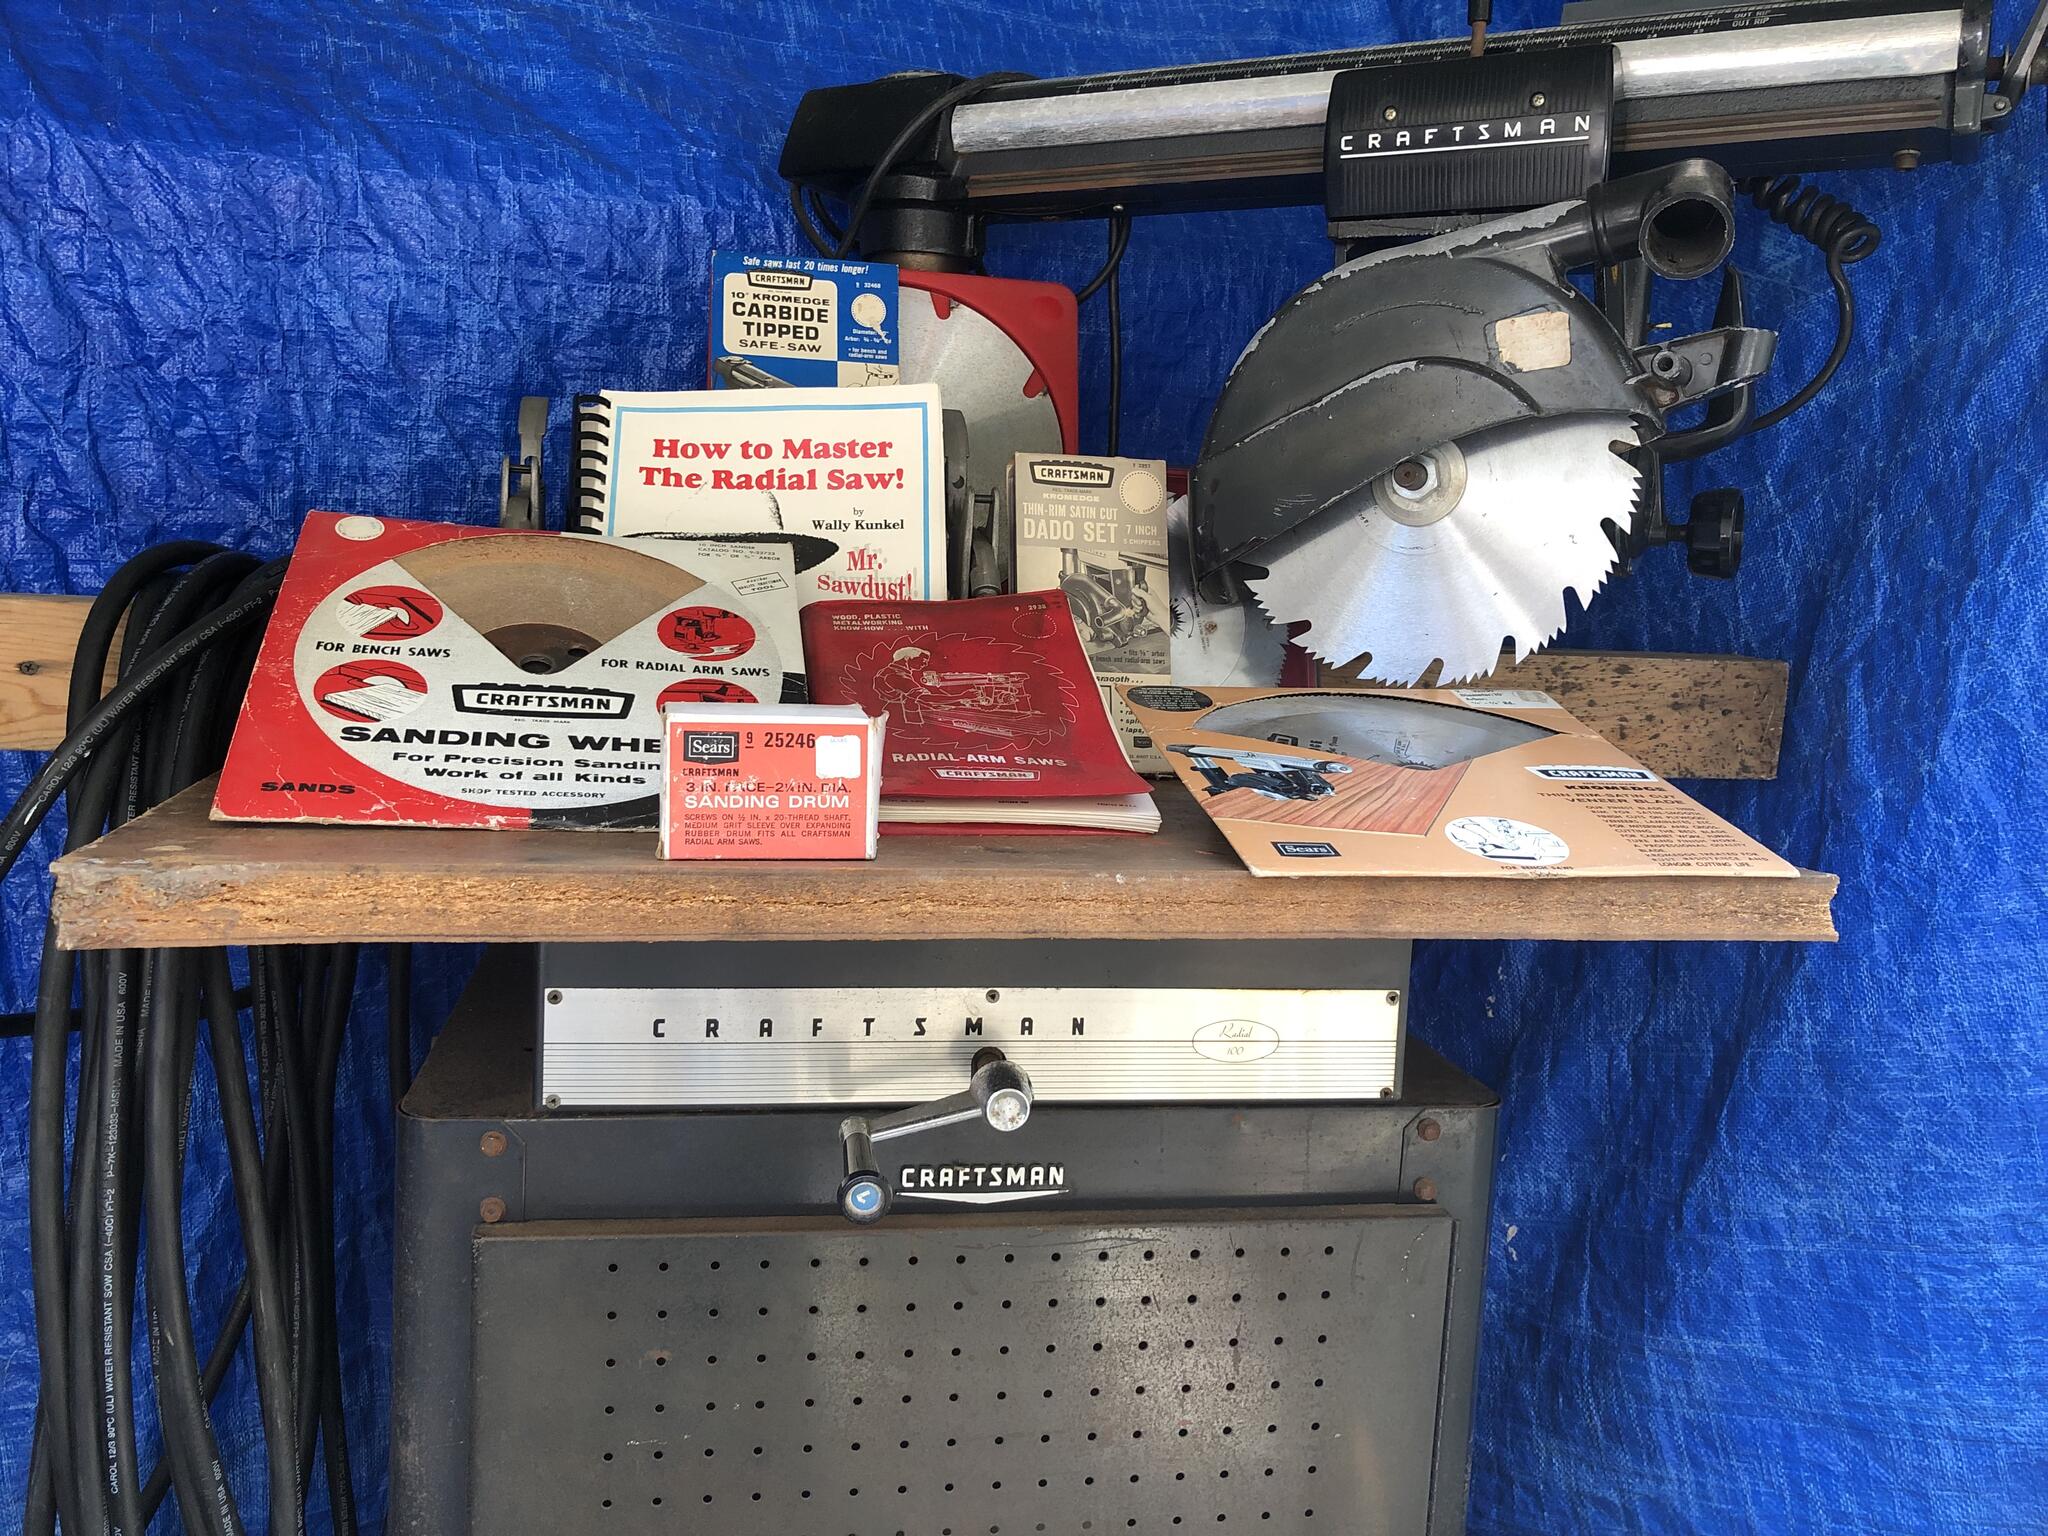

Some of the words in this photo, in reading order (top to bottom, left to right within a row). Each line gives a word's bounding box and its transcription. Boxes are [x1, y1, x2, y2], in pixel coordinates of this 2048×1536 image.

[1340, 115, 1590, 151] CRAFTSMAN
[743, 256, 760, 266] Safe
[763, 258, 782, 268] saws
[786, 259, 800, 269] last
[804, 261, 815, 270] 20
[817, 262, 838, 272] times
[841, 264, 870, 275] longer!
[755, 273, 805, 286] CRAFTSMAN
[752, 293, 830, 306] KROMEDGE
[732, 302, 829, 324] CARBIDE
[742, 321, 820, 340] TIPPED
[652, 438, 732, 460] How
[740, 440, 772, 460] to
[782, 438, 893, 460] Master
[639, 466, 702, 489] The
[712, 467, 819, 491] Radial
[827, 468, 904, 491] Saw!
[1041, 468, 1104, 481] CRAFTSMAN
[853, 507, 864, 517] by
[1023, 502, 1066, 518] THIN-RIM
[1070, 506, 1097, 519] SATIN
[1100, 508, 1118, 520] CUT
[812, 520, 850, 532] Wally
[855, 519, 904, 530] Kunkel
[1024, 518, 1074, 540] DADO
[1083, 521, 1118, 544] SET
[1135, 525, 1157, 536] INCH
[847, 548, 882, 571] Mr.
[817, 573, 912, 601] Sawdust!
[316, 640, 346, 652] FOR
[352, 644, 400, 656] BENCH
[408, 647, 450, 658] SAWS
[601, 658, 628, 668] FOR
[636, 661, 686, 672] RADIAL
[692, 666, 724, 675] ARM
[731, 667, 770, 677] SAWS
[476, 692, 610, 710] CRAFTSMAN
[39, 764, 65, 802] CAROL
[62, 754, 78, 772] 12/3
[106, 692, 137, 722] WATER
[135, 652, 178, 692] RESISTANT
[178, 639, 199, 655] SOW
[198, 626, 218, 641] CSA
[340, 726, 550, 749] SANDING
[764, 732, 816, 749] 25246
[692, 740, 730, 754] Sears
[393, 752, 434, 761] For
[444, 754, 564, 768] Precision
[892, 752, 1006, 764] RADIAL-ARM
[1014, 756, 1068, 766] SAWS
[424, 768, 488, 779] Work
[499, 771, 523, 781] of
[532, 772, 563, 782] all
[575, 773, 646, 785] Kinds
[682, 768, 740, 777] CRAFTSMAN
[1547, 770, 1641, 779] CRAFTSMAN
[260, 782, 356, 794] SANDS
[542, 791, 606, 799] ACCESSORY
[686, 782, 696, 792] 3
[700, 782, 721, 792] IN.
[684, 795, 780, 809] SANDING
[788, 795, 849, 809] DRUM
[684, 830, 720, 838] RUBBER
[726, 830, 750, 838] DRUM
[757, 830, 775, 838] FITS
[780, 830, 796, 838] ALL
[801, 830, 850, 838] CRAFTSMAN
[684, 838, 714, 846] RADIAL
[1285, 844, 1327, 854] Sears
[118, 972, 128, 995] 600V
[116, 1002, 126, 1022] USA
[116, 1026, 124, 1035] IN
[652, 1018, 1086, 1038] CRAFTSMAN
[114, 1038, 124, 1068] MADE
[901, 1166, 1064, 1188] CRAFTSMAN
[104, 1216, 114, 1246] (-40C)
[104, 1250, 113, 1271] CSA
[103, 1274, 113, 1298] SOW
[103, 1302, 114, 1355] RESISTANT
[104, 1358, 114, 1393] WATER
[106, 1396, 114, 1414] (UL)
[108, 1440, 117, 1459] 12/3
[110, 1462, 118, 1494] CAROL
[212, 1460, 222, 1480] 600V
[217, 1486, 227, 1500] USA
[220, 1502, 231, 1515] IN
